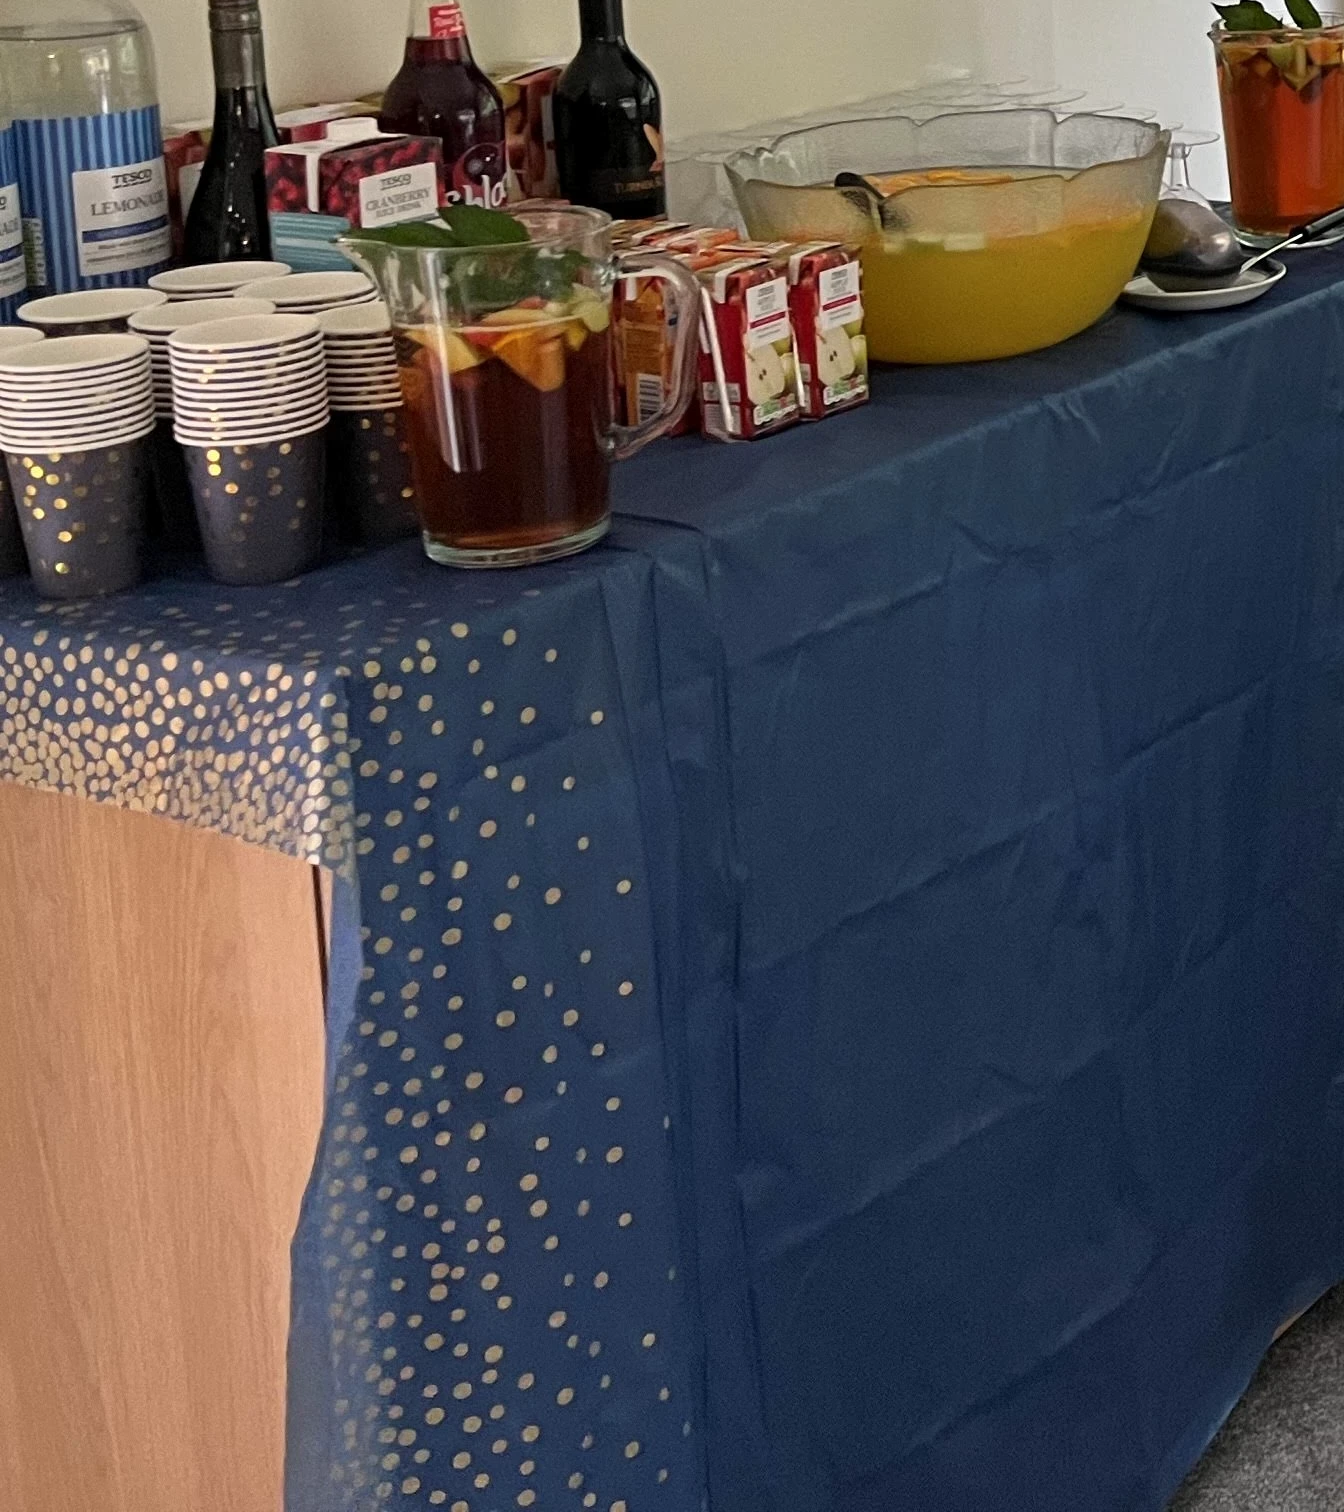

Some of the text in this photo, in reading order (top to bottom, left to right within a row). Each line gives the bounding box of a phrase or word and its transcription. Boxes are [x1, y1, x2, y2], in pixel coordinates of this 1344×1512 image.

[111, 168, 153, 186] TESCO
[380, 172, 412, 187] TESCO
[90, 190, 165, 217] LEMONADE
[366, 187, 431, 211] CRANBERRY
